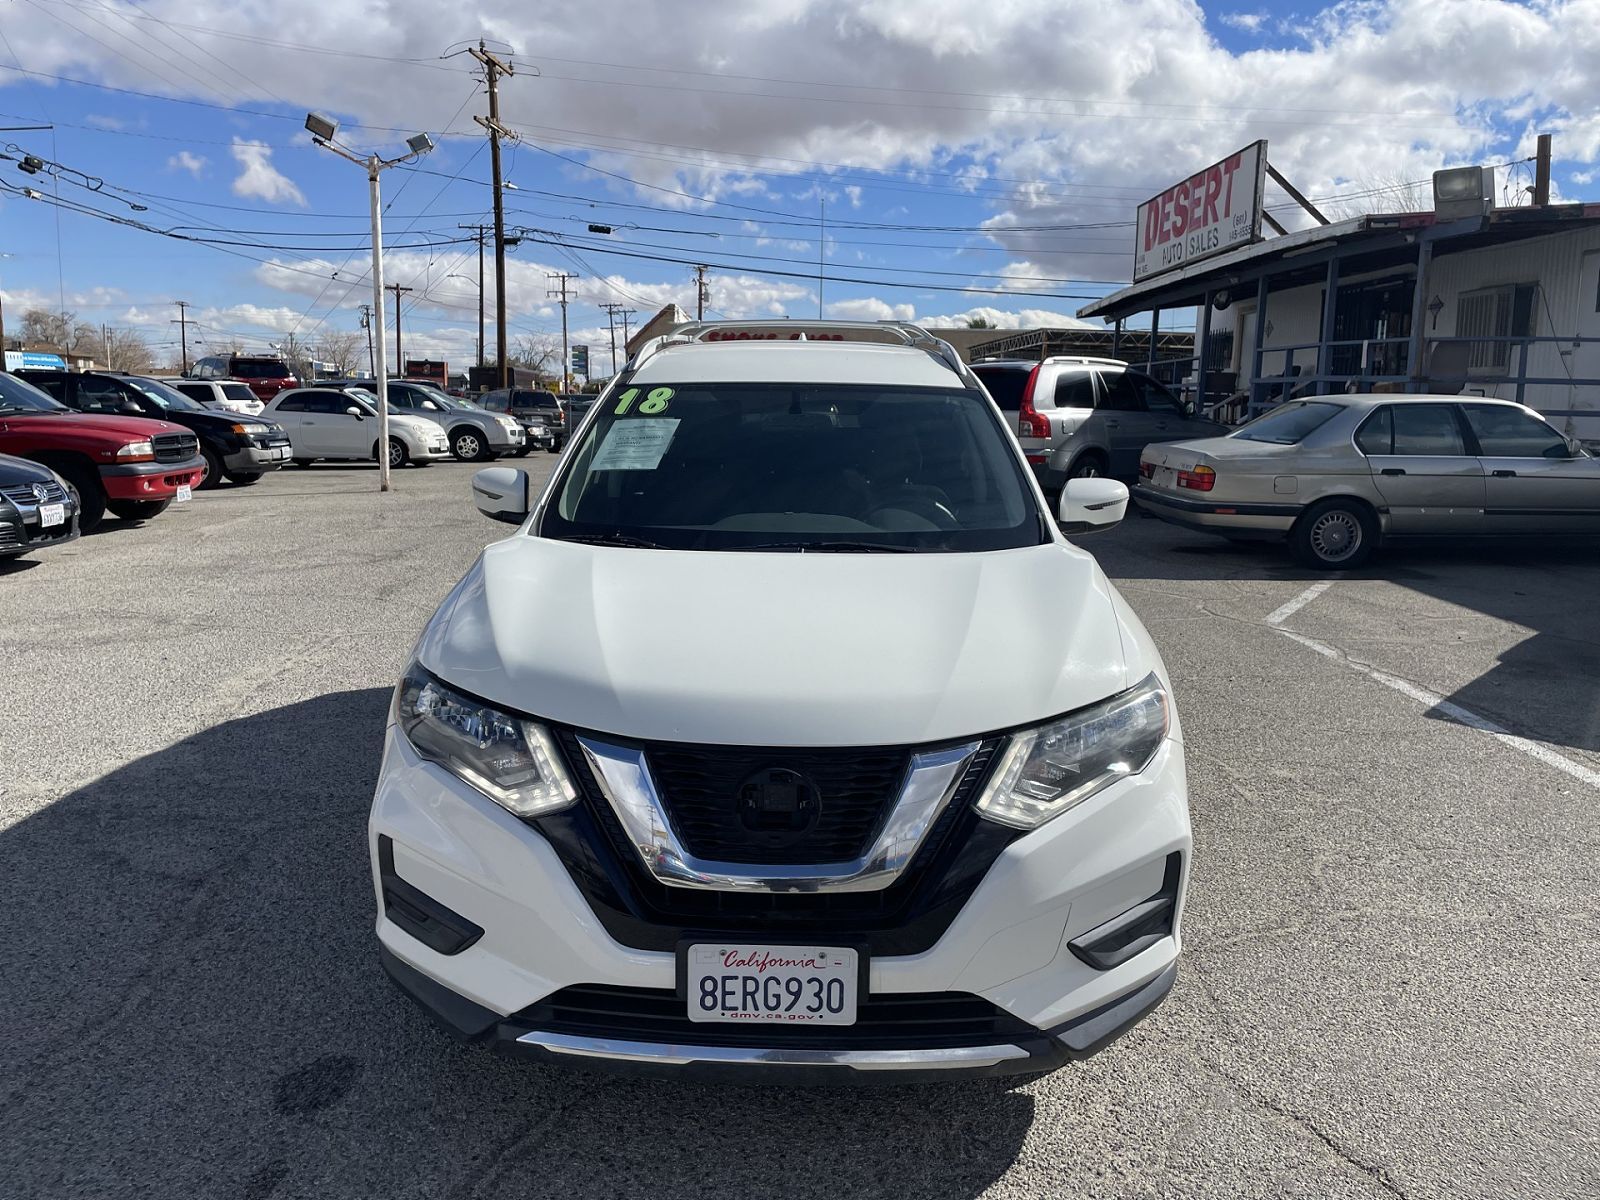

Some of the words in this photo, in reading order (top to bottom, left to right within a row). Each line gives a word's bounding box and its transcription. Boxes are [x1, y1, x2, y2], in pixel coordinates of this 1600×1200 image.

[1144, 153, 1242, 252] DESERT
[1162, 242, 1183, 265] AUTO
[1189, 227, 1219, 255] SALES
[614, 387, 675, 415] 18
[723, 950, 826, 973] California
[699, 975, 845, 1014] 8ERG930
[730, 1012, 815, 1020] dmv.ca.gov
